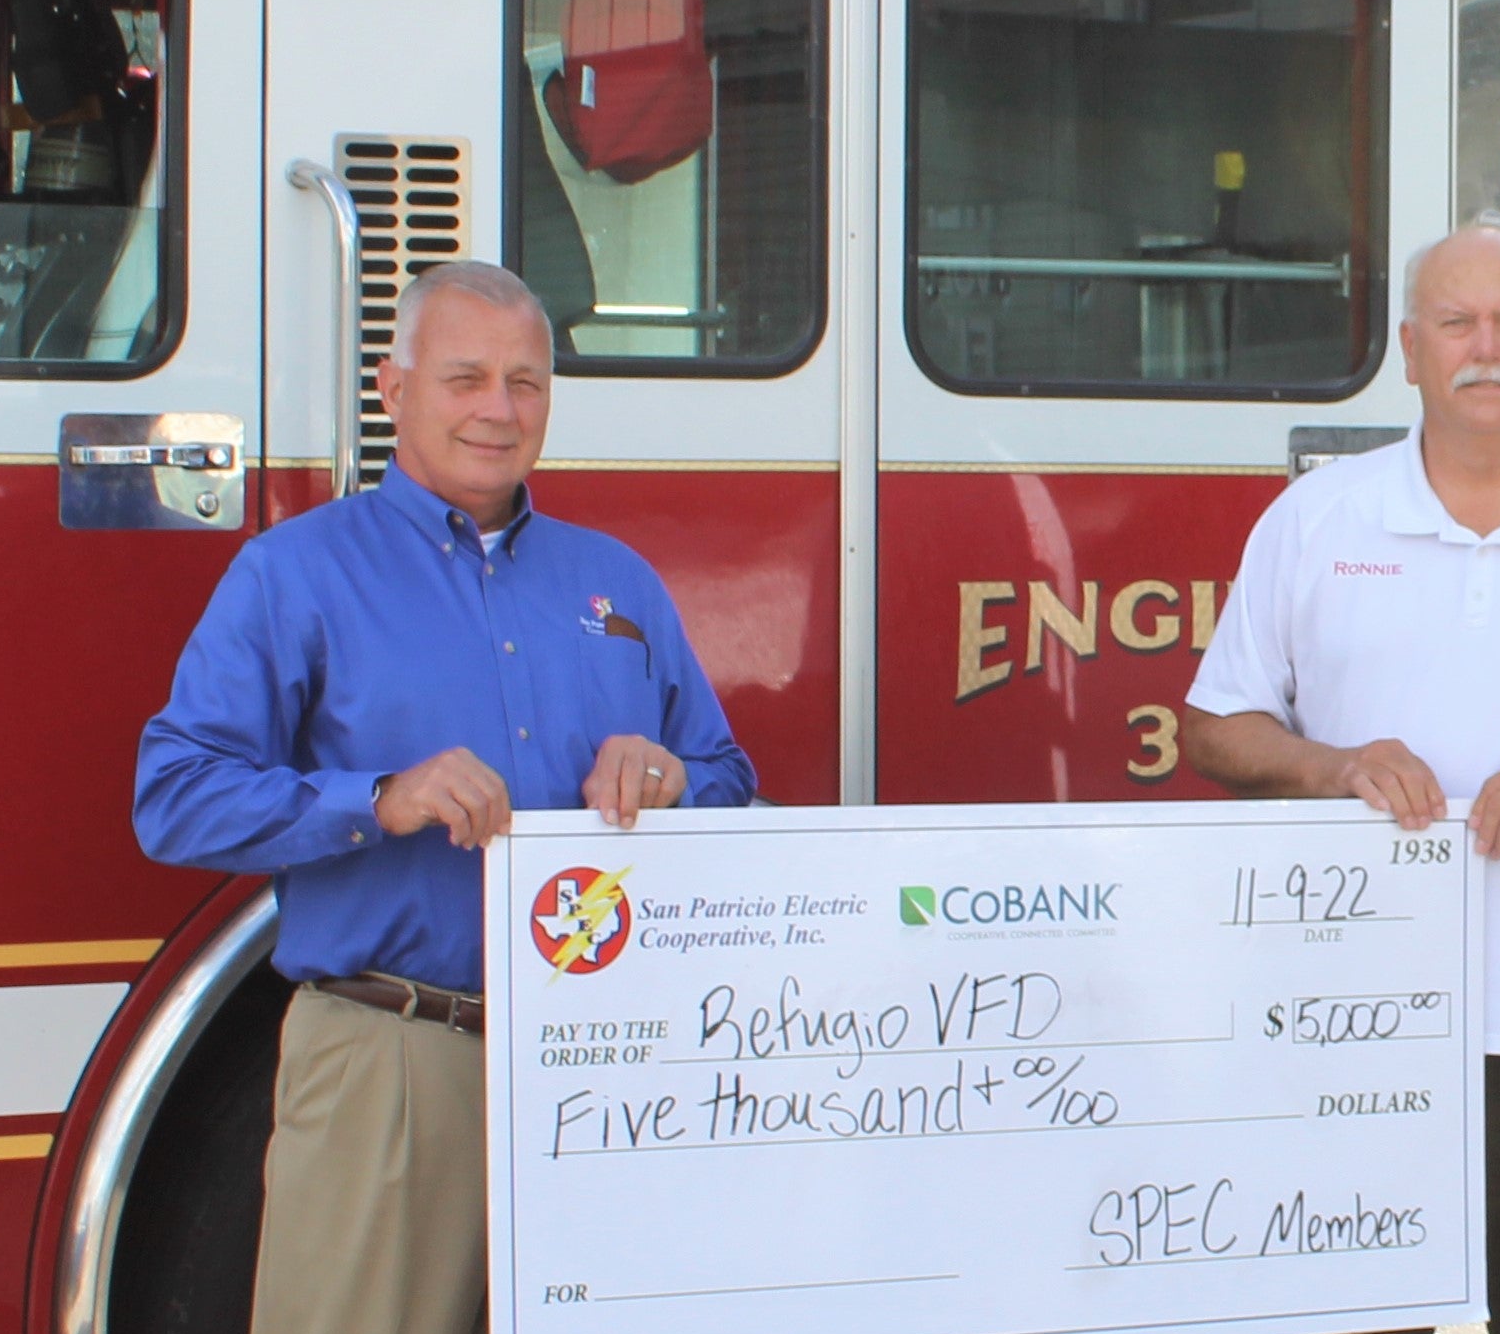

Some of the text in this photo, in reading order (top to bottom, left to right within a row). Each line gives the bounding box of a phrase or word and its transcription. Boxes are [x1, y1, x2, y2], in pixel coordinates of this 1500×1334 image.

[955, 579, 1236, 704] ENGI
[1127, 704, 1180, 783] 3
[1390, 839, 1452, 865] 1938
[638, 892, 868, 921] San Patricio Electric
[1233, 864, 1376, 927] 11-9-22
[639, 924, 826, 954] Cooperative, Inc.
[1303, 928, 1344, 943] DATE
[540, 1020, 669, 1043] PAY TO THE
[699, 972, 1062, 1079] Refugio VFD
[1263, 1002, 1285, 1040] $
[540, 1045, 653, 1067] ORDER OF
[553, 1089, 686, 1159] Five
[698, 1059, 964, 1140] thousand
[1317, 1090, 1432, 1117] DOLLARS
[1090, 1178, 1427, 1266] SPEC Members
[543, 1283, 589, 1305] FOR
